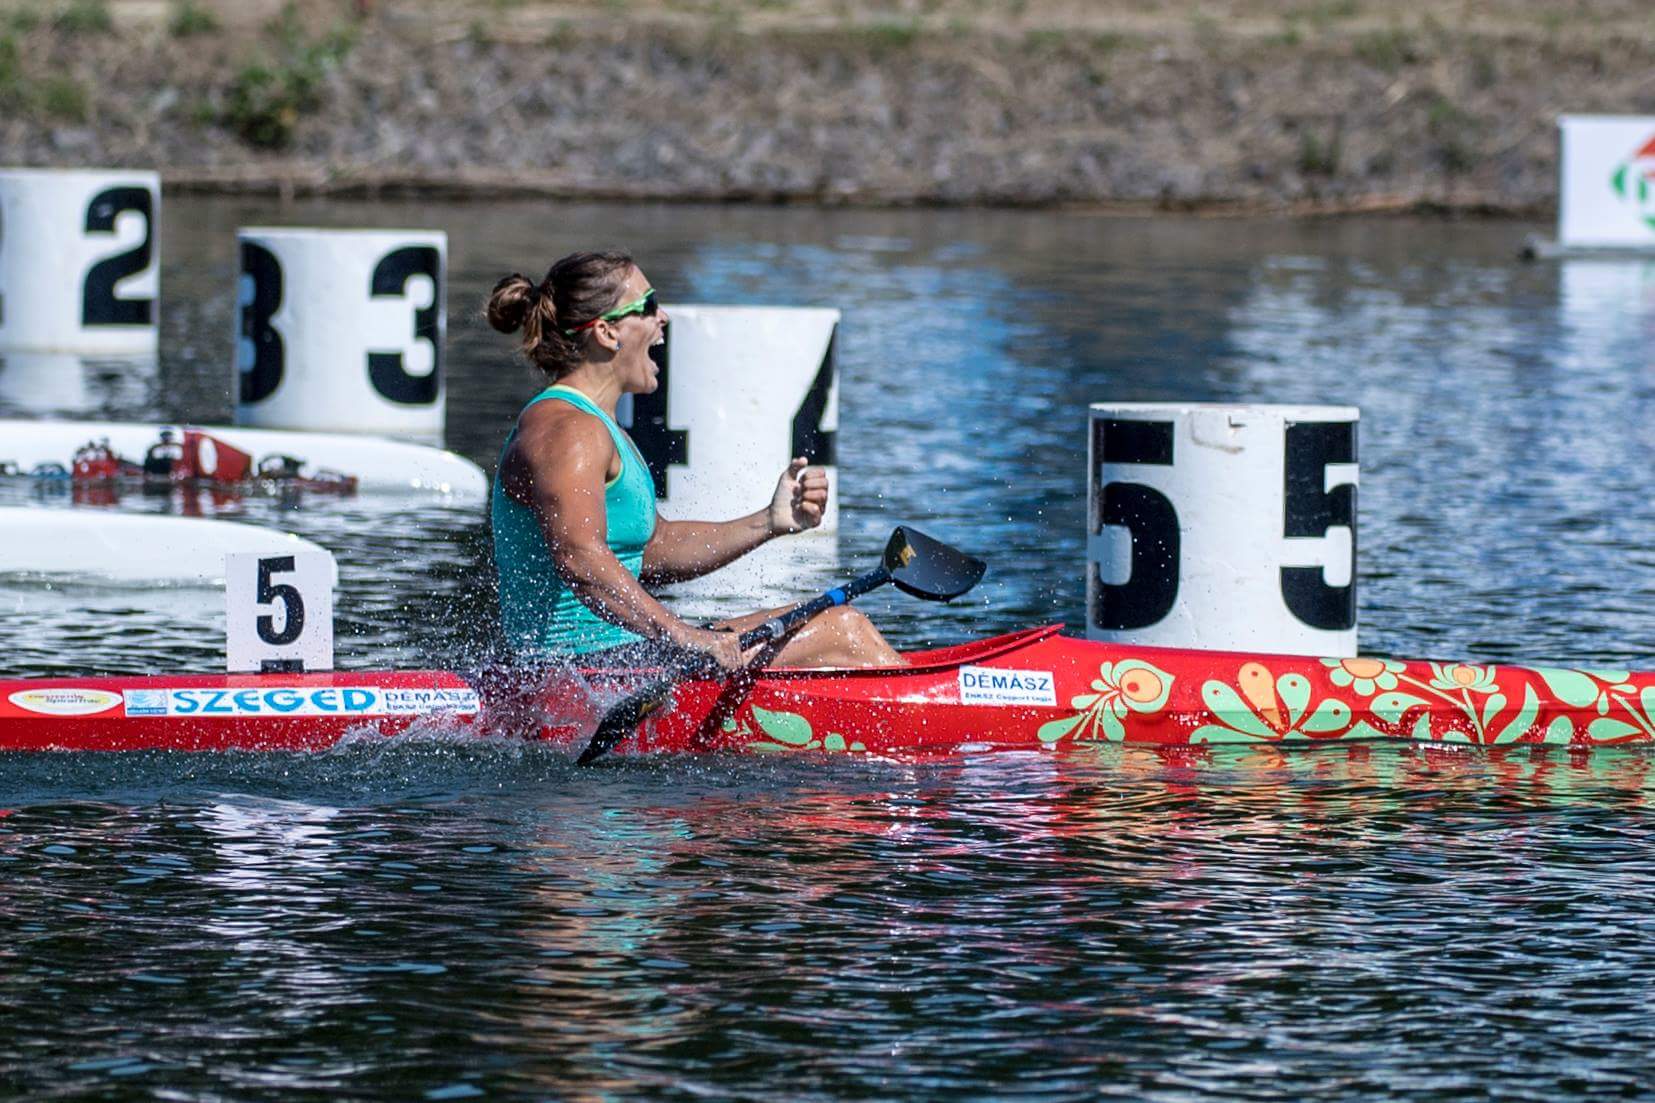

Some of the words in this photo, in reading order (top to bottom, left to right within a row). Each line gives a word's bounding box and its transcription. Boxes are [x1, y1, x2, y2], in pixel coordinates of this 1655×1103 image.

[82, 186, 153, 325] 2
[367, 246, 440, 404] 3
[1091, 419, 1180, 630] 5
[1279, 420, 1357, 630] 5
[256, 555, 305, 646] 5
[173, 689, 376, 713] SZEGED
[963, 672, 1050, 691] DÉMÁSZ
